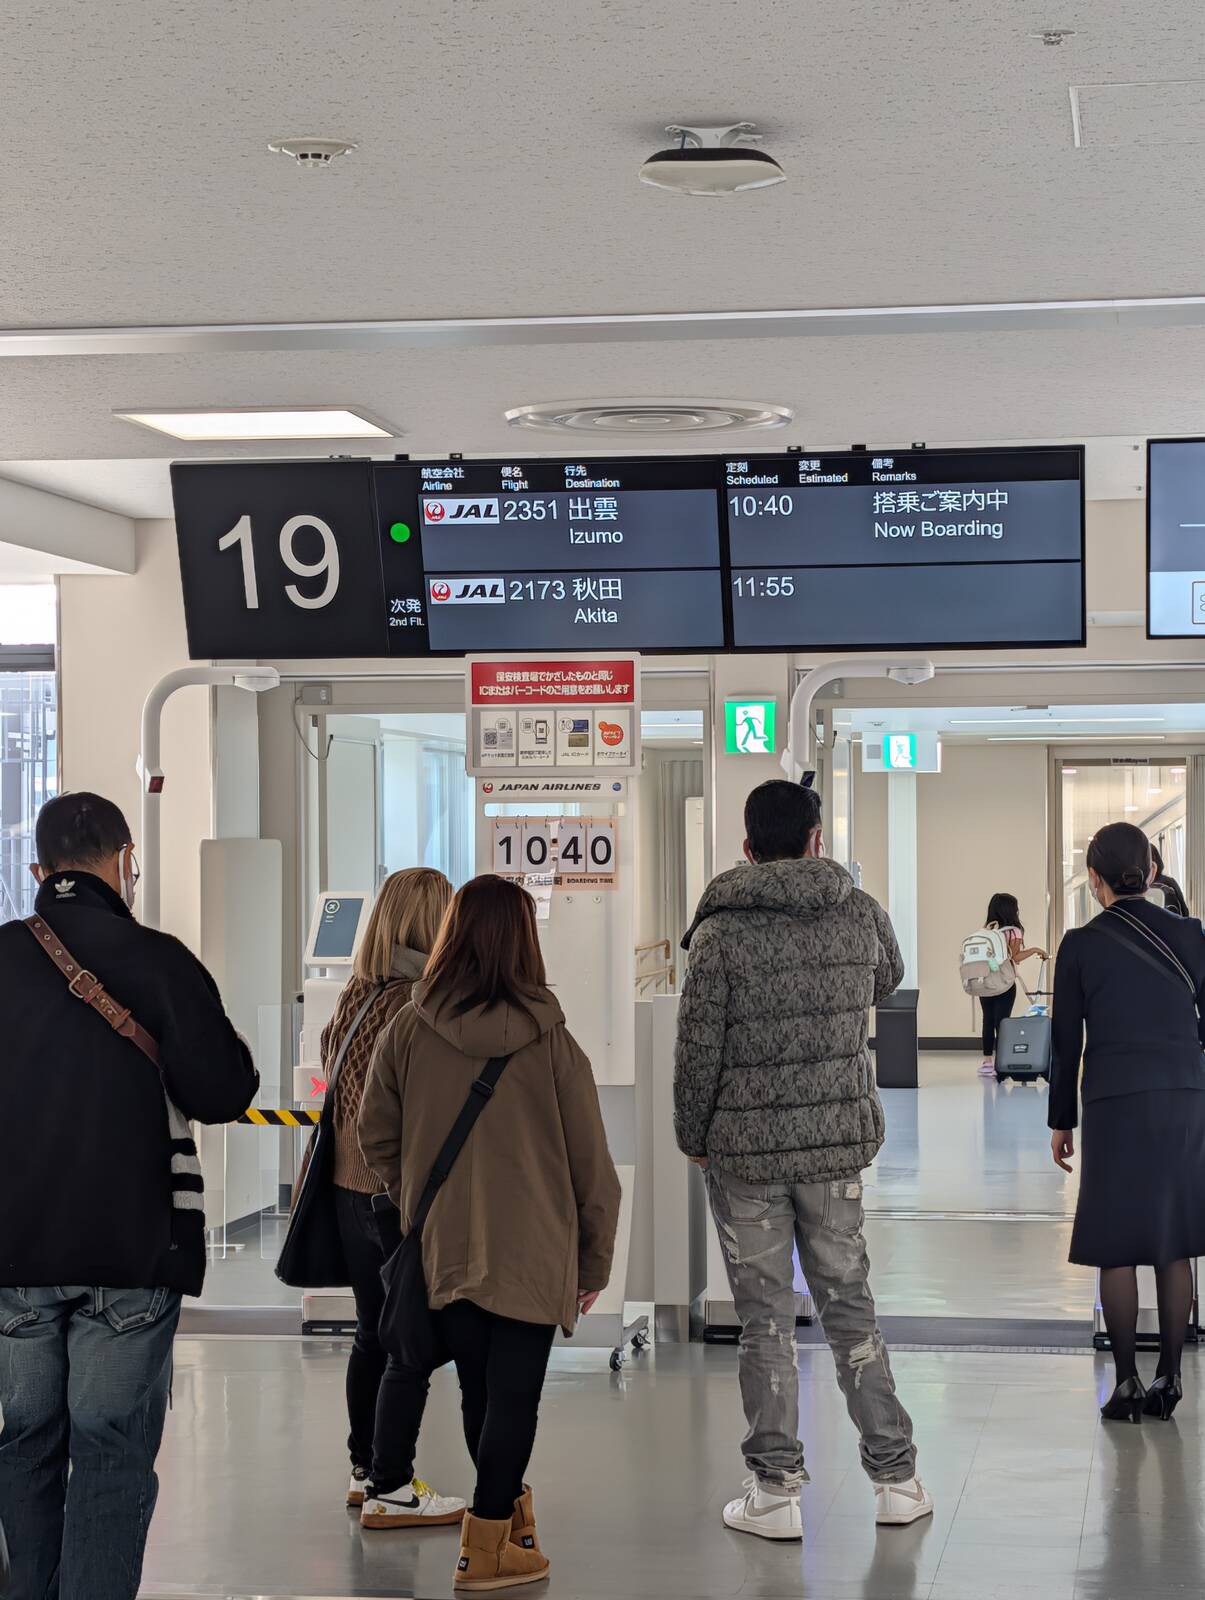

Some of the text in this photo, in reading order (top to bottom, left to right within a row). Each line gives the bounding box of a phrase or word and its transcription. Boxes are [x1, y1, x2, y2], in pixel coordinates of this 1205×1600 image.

[725, 461, 748, 473] 定刻
[798, 460, 821, 472] 変更
[871, 458, 894, 470] 備考
[421, 467, 464, 479] 航空会社
[501, 466, 523, 478] 便名
[564, 465, 588, 477] 行先
[872, 471, 917, 482] Remarks
[565, 478, 620, 489] Destination
[726, 474, 779, 486] Scheduled
[799, 472, 849, 484] Estimated
[421, 481, 453, 491] Airline
[501, 479, 529, 492] Flight
[729, 495, 793, 517] 10:40
[872, 489, 1009, 514] 搭乗ご案内中
[449, 499, 557, 521] JAL 2351
[568, 497, 619, 521] 出雲
[874, 519, 1004, 539] Now Boarding
[569, 528, 624, 544] Izumo
[218, 514, 340, 610] 19
[455, 580, 566, 601] JAL 2173
[572, 577, 623, 601] 秋田
[733, 576, 795, 597] 11:55
[390, 598, 422, 614] 次発
[389, 616, 408, 627] 2nd
[574, 607, 618, 624] Akita
[498, 783, 601, 792] JAPAN AIRLINES
